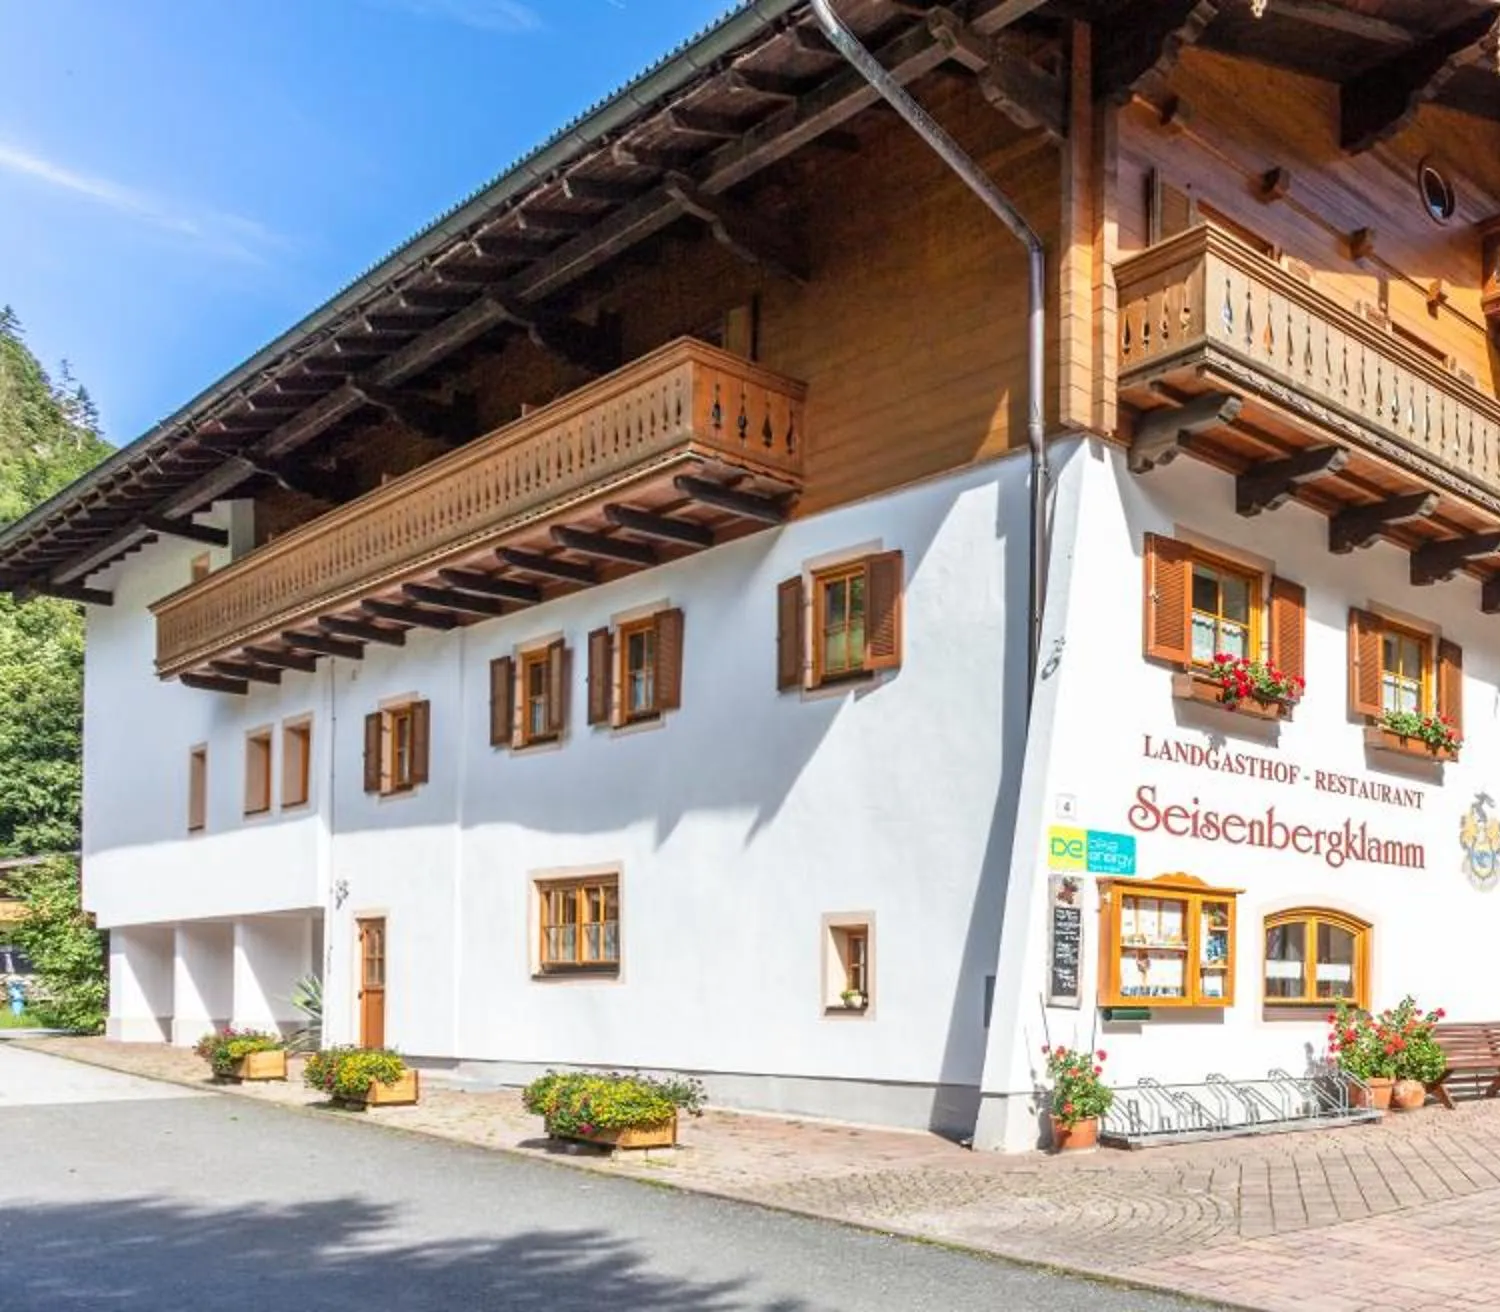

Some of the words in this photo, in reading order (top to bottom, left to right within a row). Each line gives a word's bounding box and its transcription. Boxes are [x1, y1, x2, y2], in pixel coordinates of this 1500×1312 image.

[1143, 734, 1301, 785] LANDGASTHOF
[1314, 769, 1425, 810] RESTAURANT
[1128, 784, 1427, 869] Seisenbergklamm
